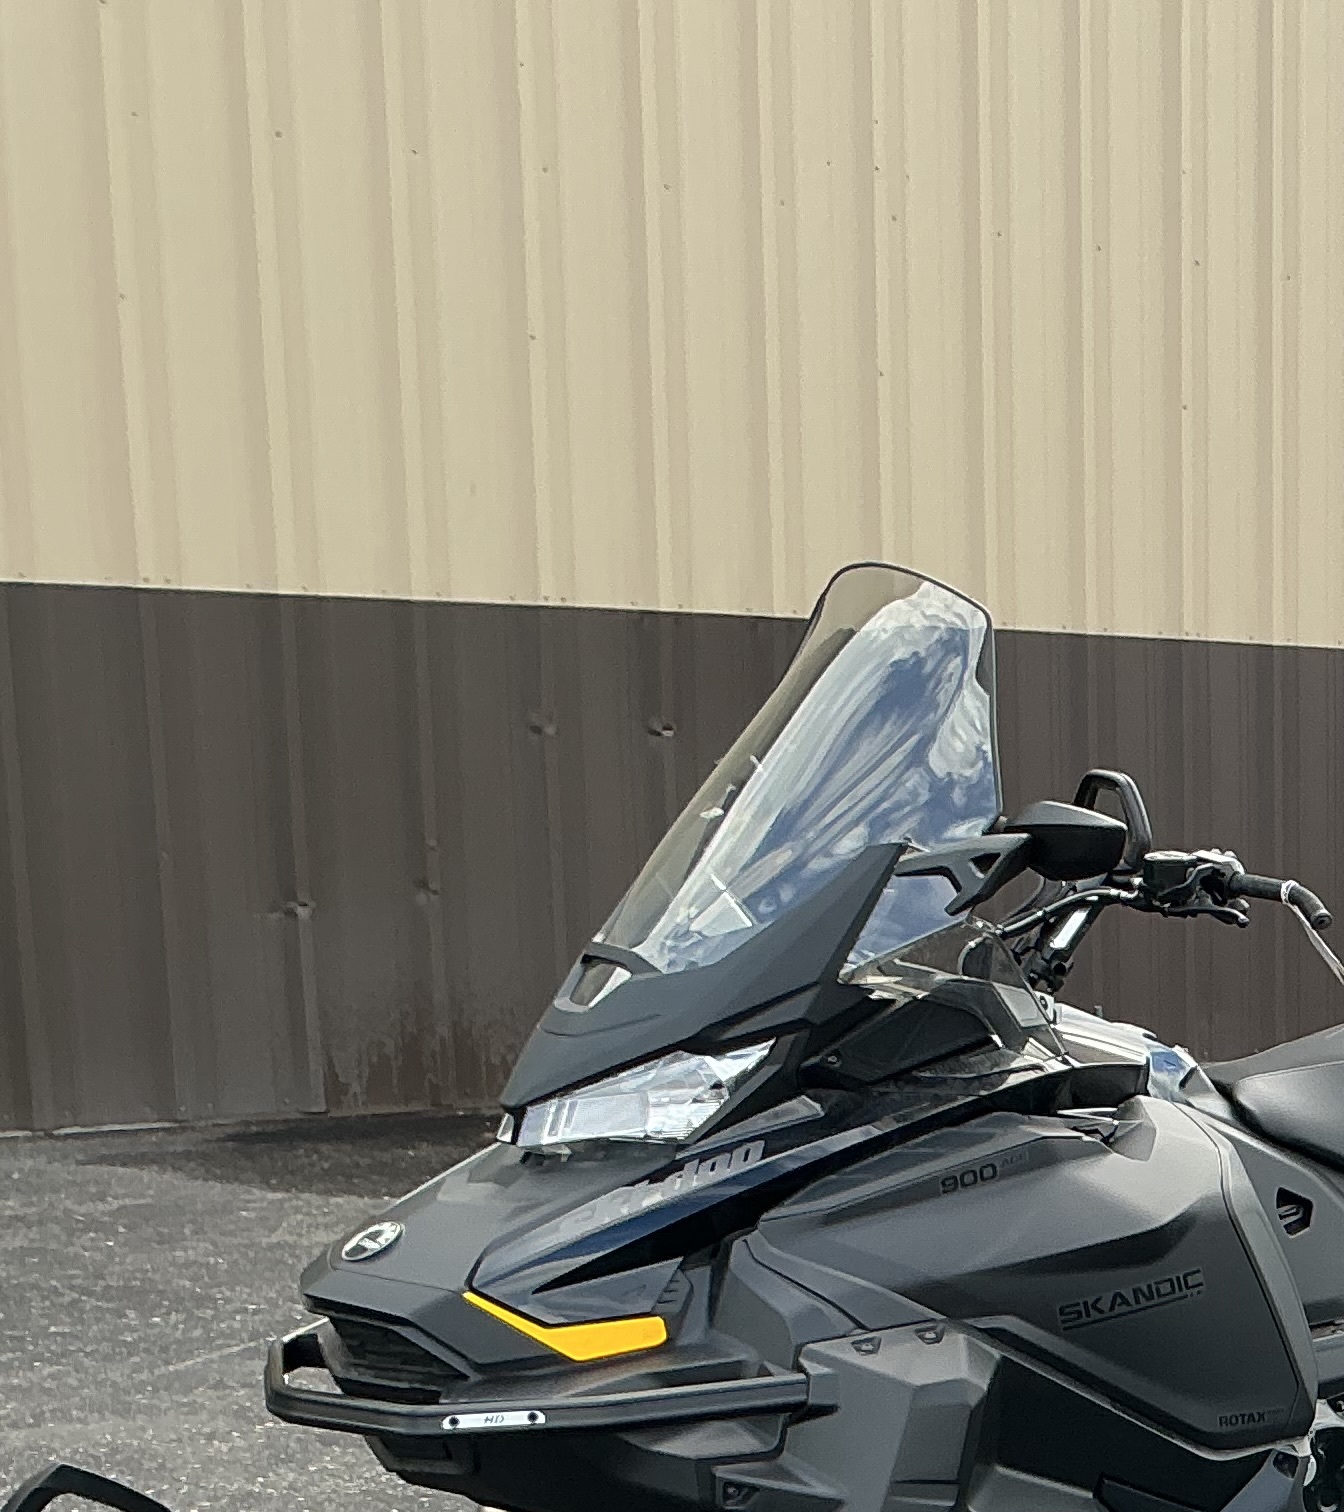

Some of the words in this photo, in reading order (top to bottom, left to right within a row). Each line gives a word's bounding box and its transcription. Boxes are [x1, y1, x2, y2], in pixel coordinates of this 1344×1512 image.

[941, 1163, 997, 1194] 900
[1059, 1268, 1203, 1325] SKANDIC
[483, 1414, 505, 1425] HD
[1218, 1411, 1266, 1427] ROTAX
